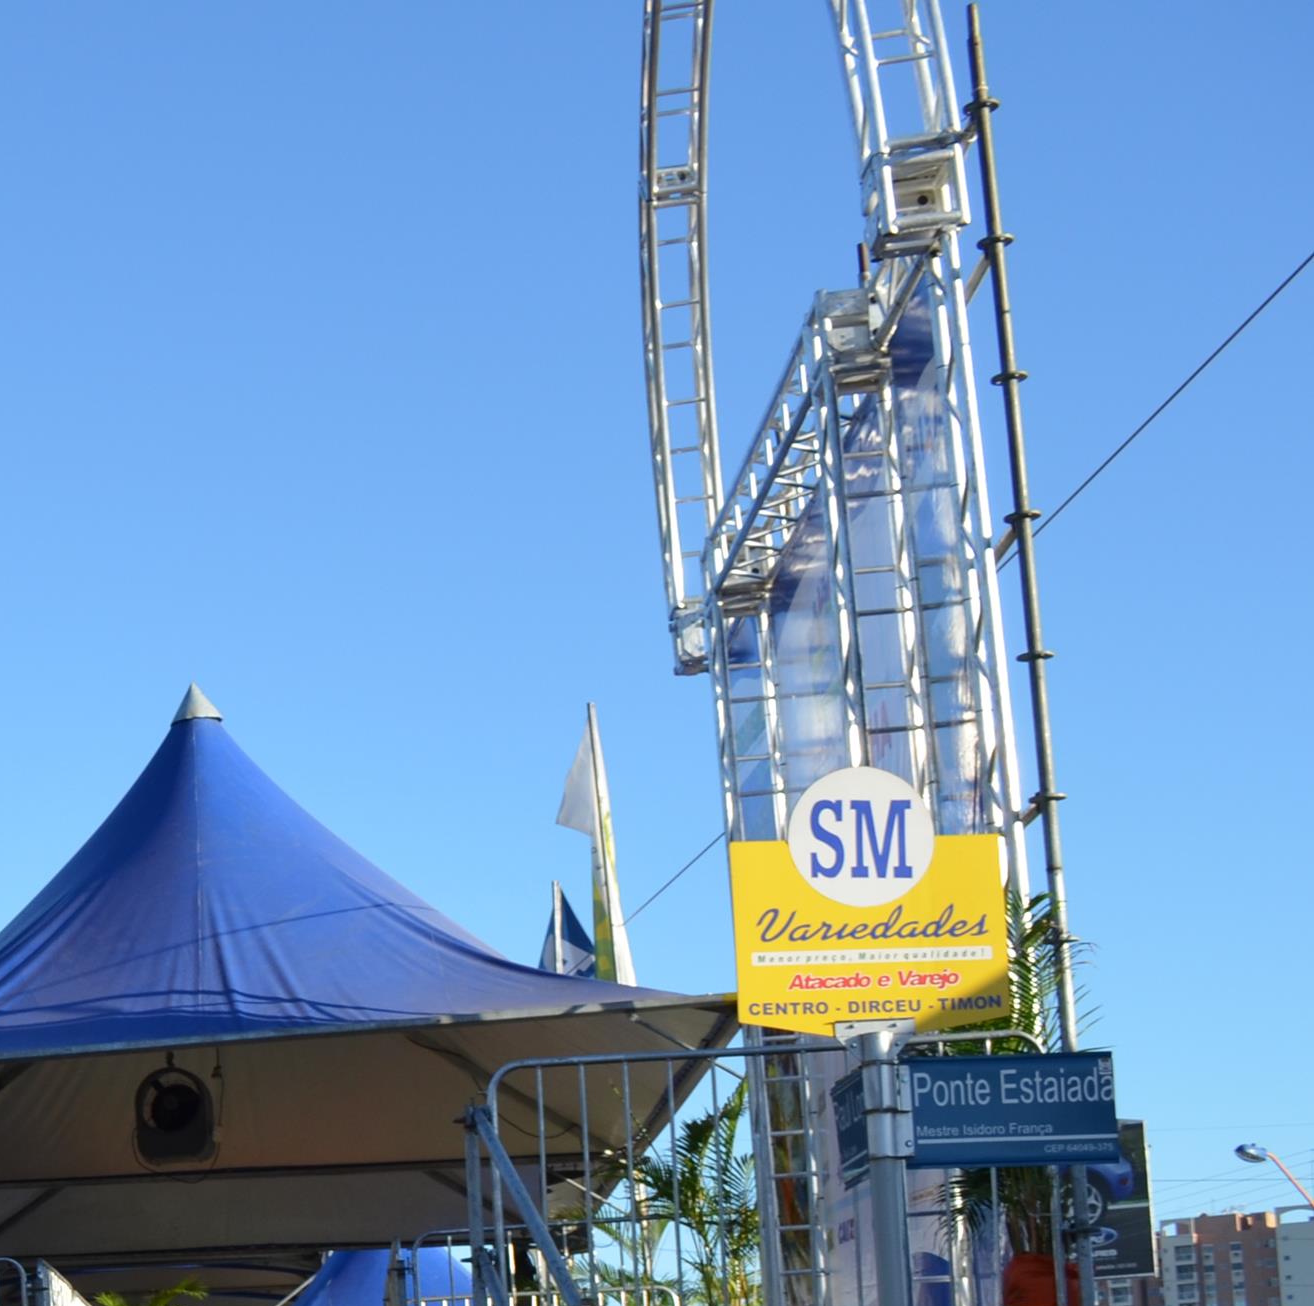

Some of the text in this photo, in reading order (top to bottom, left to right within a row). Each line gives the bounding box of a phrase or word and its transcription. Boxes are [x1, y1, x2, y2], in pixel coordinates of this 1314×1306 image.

[810, 799, 913, 879] SM
[756, 903, 989, 942] Variedades
[757, 954, 800, 964] Menor
[858, 951, 898, 961] Maior
[788, 968, 960, 991] Atacado e Varejo
[748, 1001, 829, 1017] CENTRO
[847, 999, 921, 1014] DIRCEU
[938, 995, 1002, 1011] TIMON
[912, 1067, 1115, 1107] Ponte Estaiada
[916, 1121, 1053, 1138] Mestre Isidoro França
